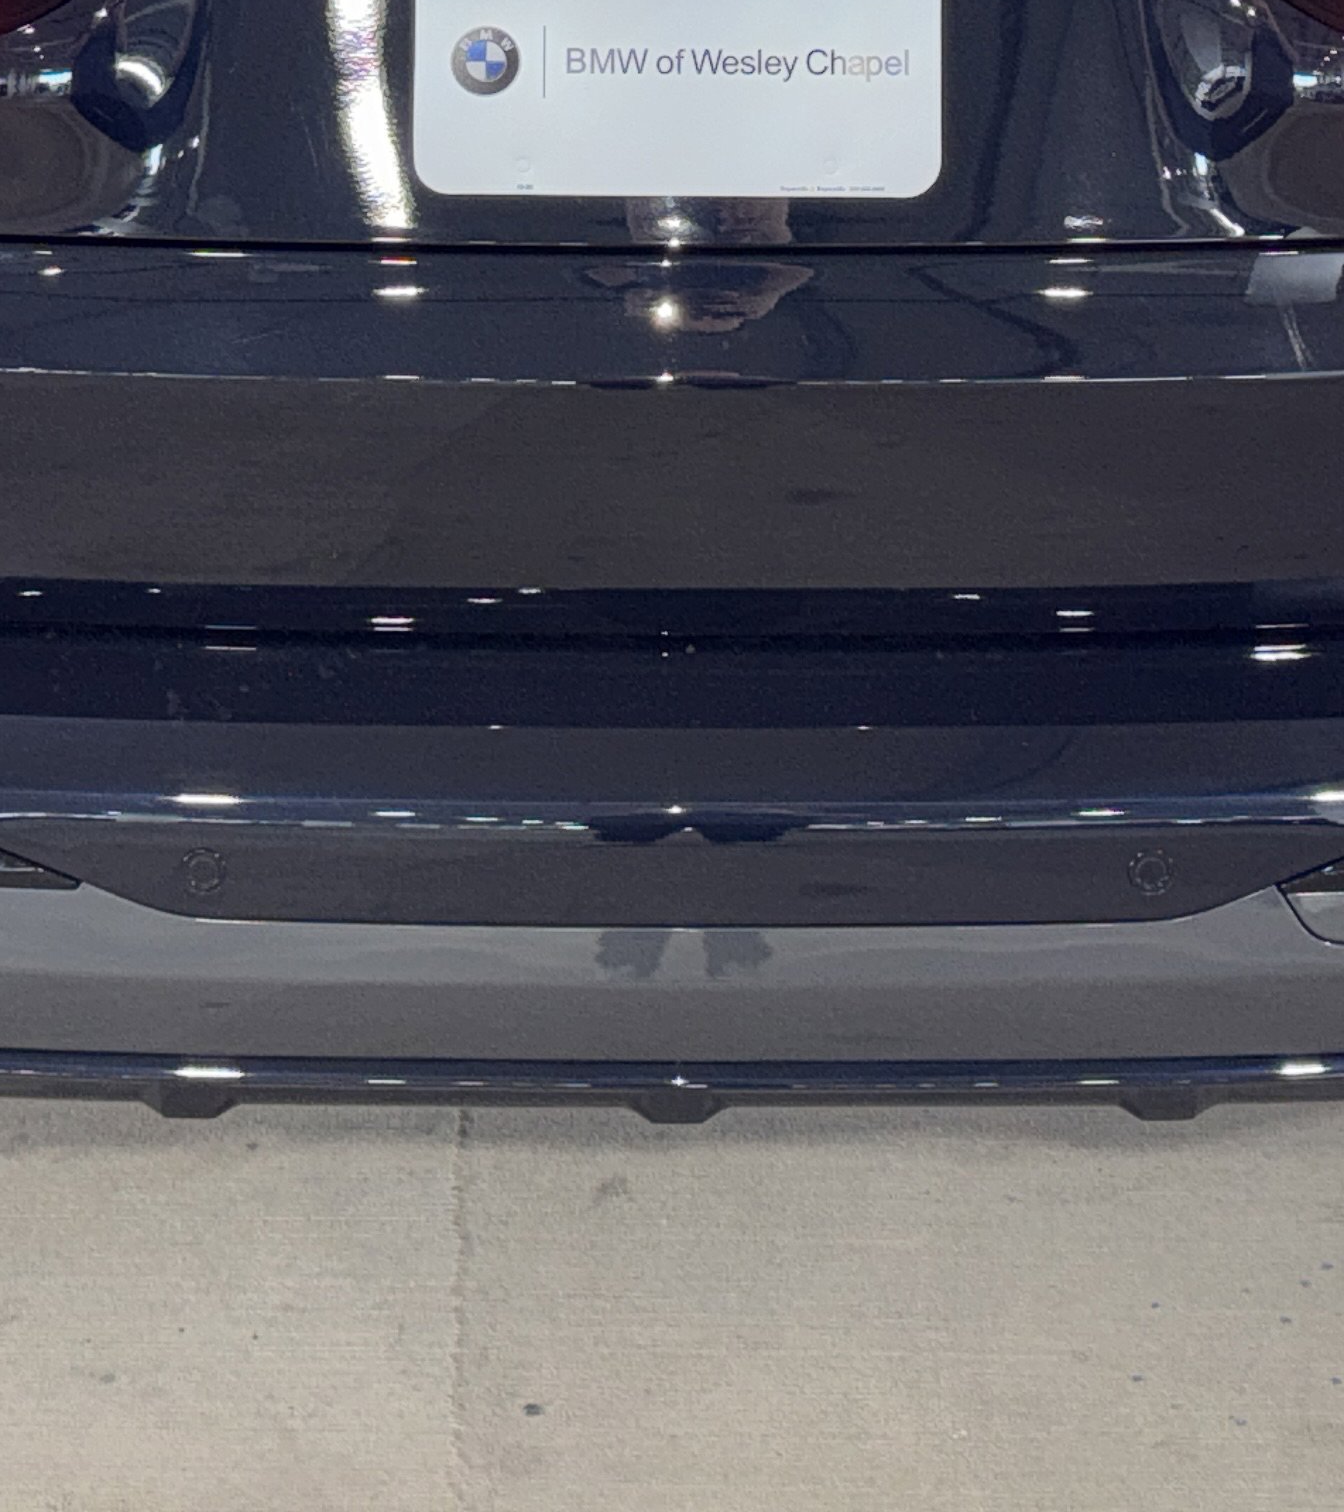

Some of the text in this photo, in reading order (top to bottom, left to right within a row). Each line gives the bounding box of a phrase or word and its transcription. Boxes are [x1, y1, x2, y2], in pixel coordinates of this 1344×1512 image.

[459, 29, 515, 52] BMW
[565, 47, 910, 83] BMW of Wesley Chapel
